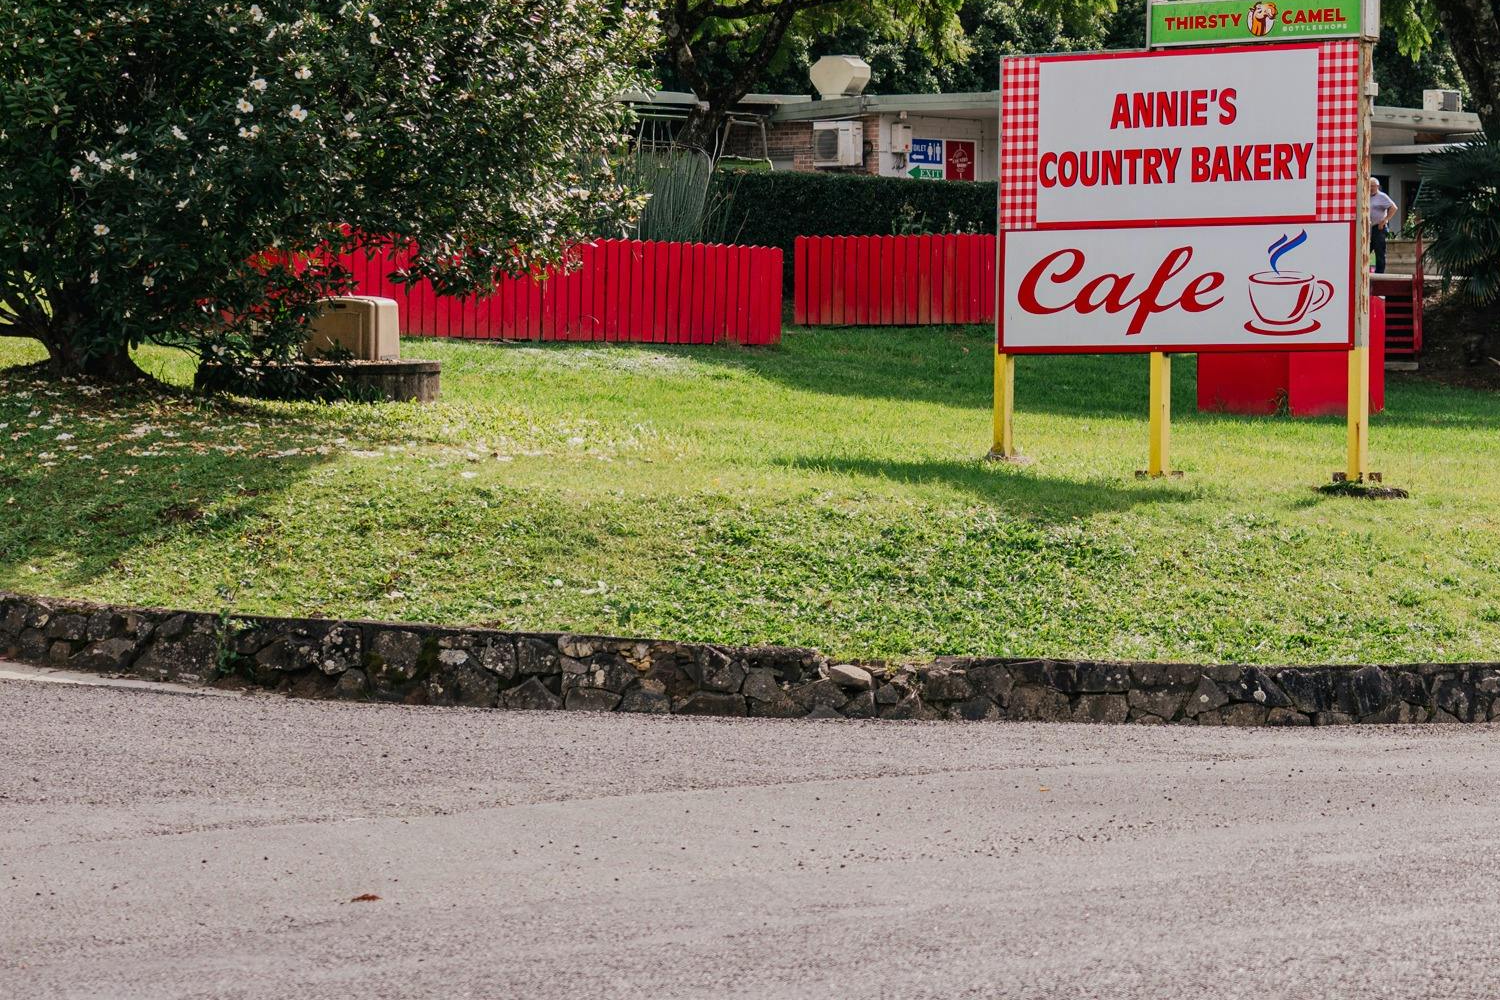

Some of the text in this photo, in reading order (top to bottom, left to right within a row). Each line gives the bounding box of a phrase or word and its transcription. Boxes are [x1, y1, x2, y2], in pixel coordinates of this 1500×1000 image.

[1165, 8, 1346, 31] THIRSTY CAMEL
[1282, 23, 1348, 33] BOTTLESHOPS
[1110, 88, 1238, 130] ANNIE'S
[912, 143, 926, 152] OILET
[920, 169, 942, 178] EXIT
[1039, 142, 1314, 188] COUNTRY BAKERY
[1017, 245, 1225, 336] Cafe
